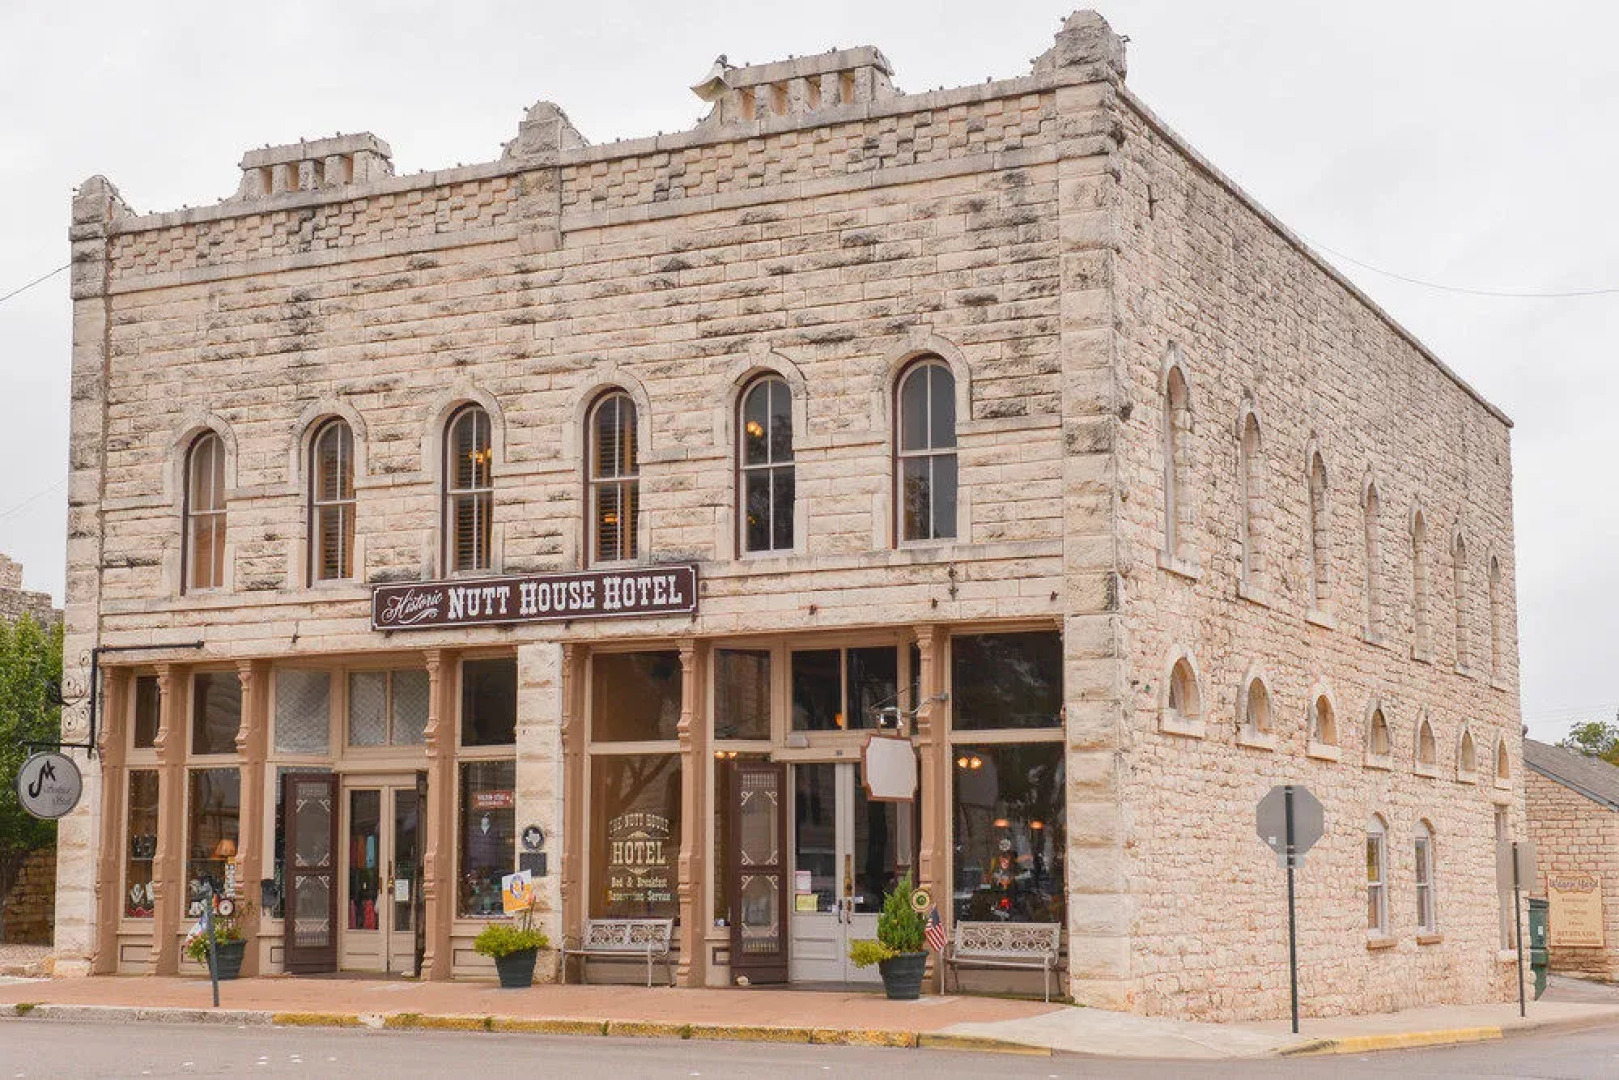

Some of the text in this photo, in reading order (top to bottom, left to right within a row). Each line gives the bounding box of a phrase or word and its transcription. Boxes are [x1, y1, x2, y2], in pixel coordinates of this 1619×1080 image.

[382, 575, 682, 623] Historic NUTT HOUSE HOTEL
[612, 841, 666, 864] HOTEL
